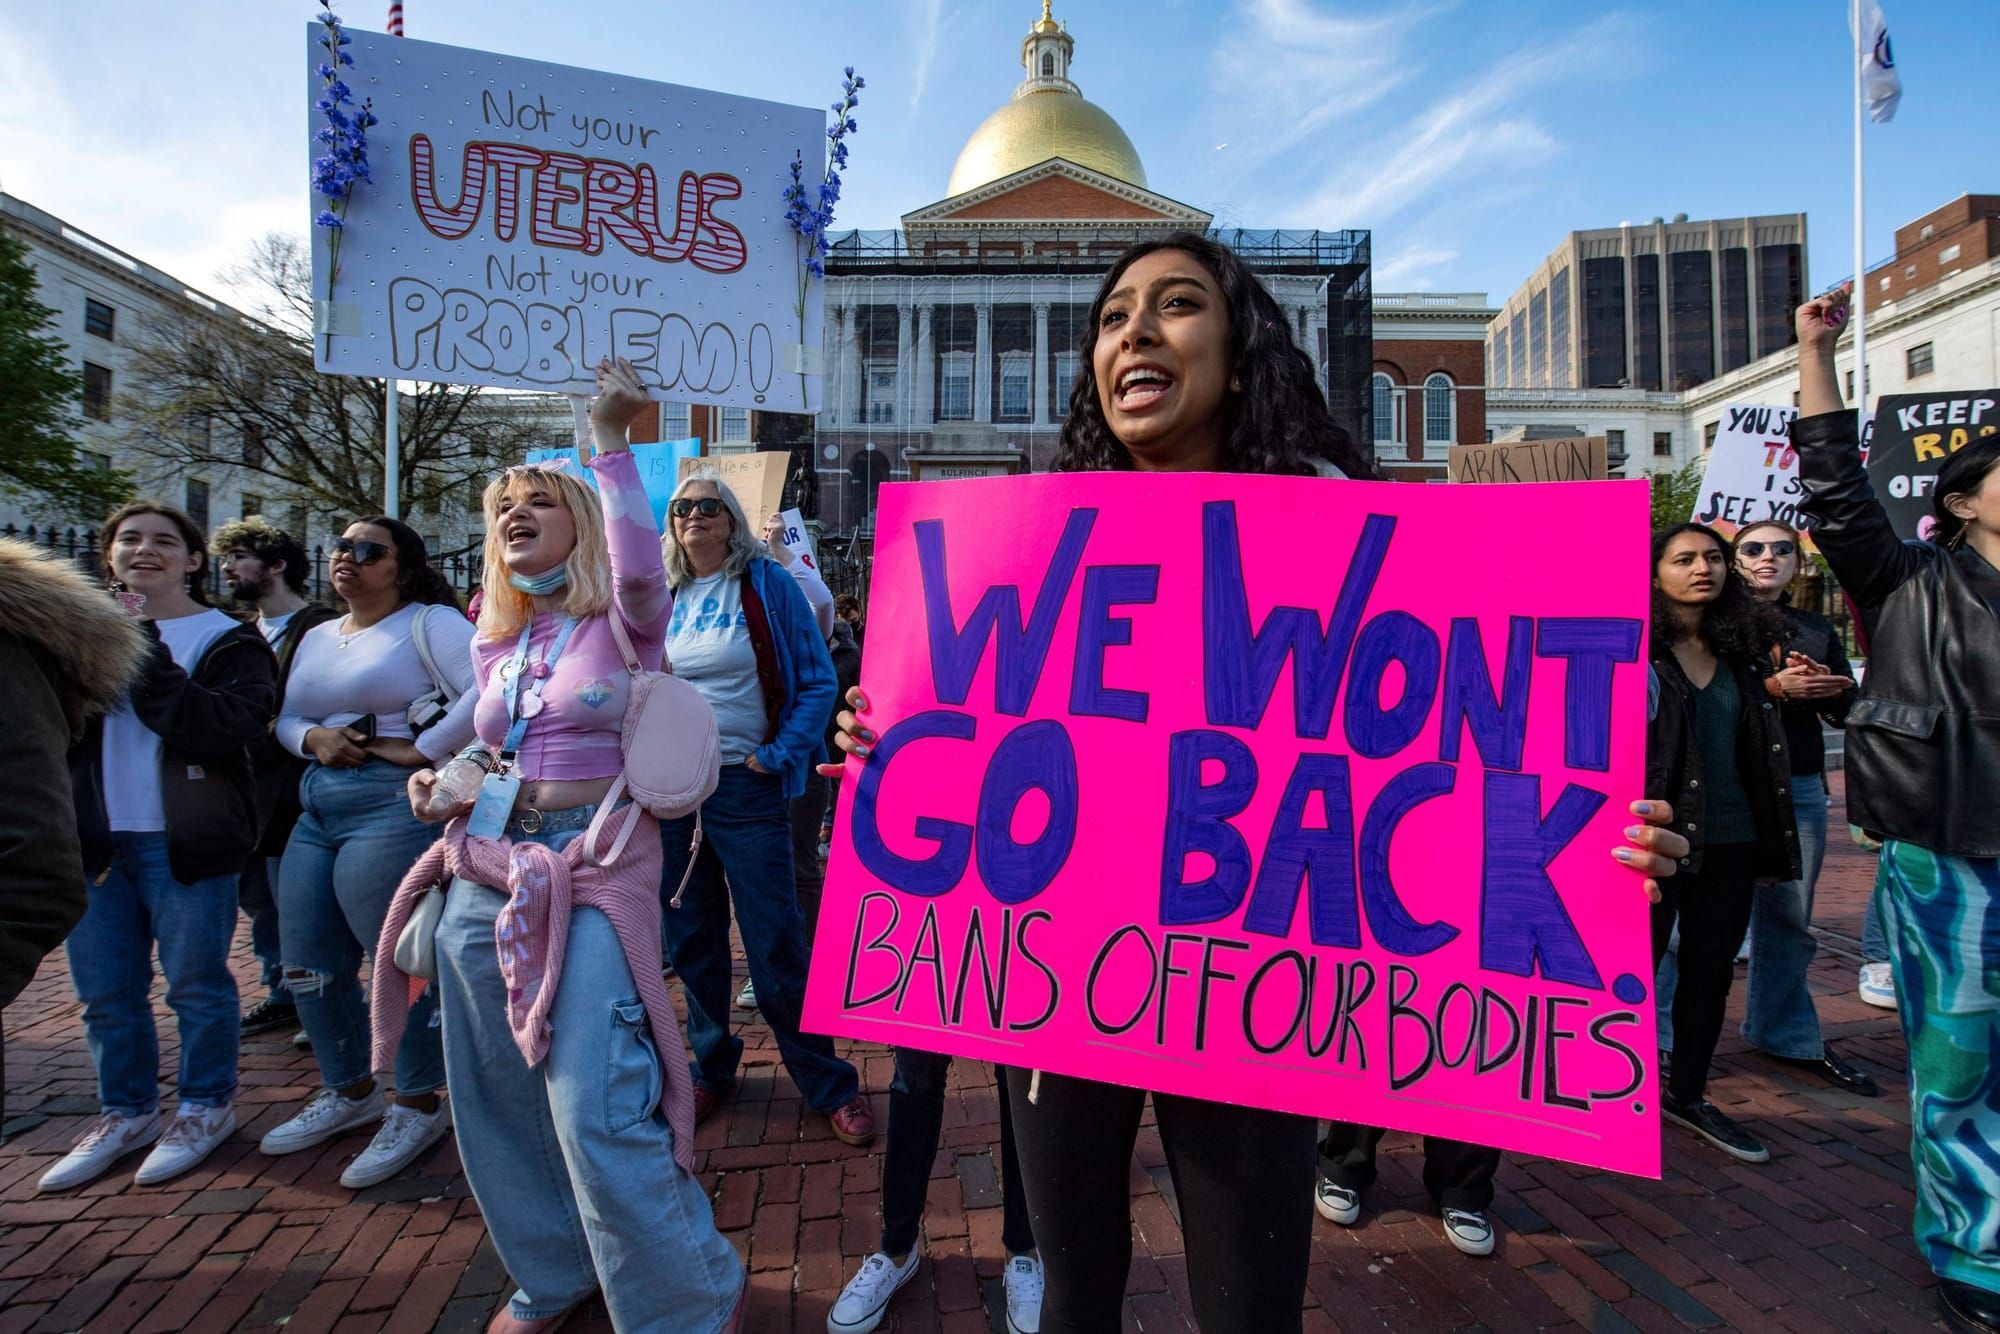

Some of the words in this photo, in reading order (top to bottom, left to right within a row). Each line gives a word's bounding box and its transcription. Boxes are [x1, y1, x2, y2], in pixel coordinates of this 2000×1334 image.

[482, 89, 555, 132] Not
[571, 112, 659, 150] your
[410, 133, 747, 273] UTERUS
[486, 255, 552, 296] Not
[570, 269, 653, 303] your
[389, 276, 774, 403] PROBLEM!
[1727, 407, 1772, 435] YOU
[1897, 398, 1996, 432] KEEP
[940, 468, 988, 478] BULFINCH
[1460, 441, 1593, 483] ABORTION
[1700, 491, 1757, 526] SEE
[913, 508, 1160, 723] WE
[1202, 501, 1644, 772] WONT
[851, 710, 1078, 904] GO
[1160, 730, 1648, 1004] BACK.
[842, 890, 1062, 1032] BANS
[1086, 923, 1251, 1052] OFF
[1241, 949, 1376, 1071] OUR
[1387, 963, 1647, 1115] BODIES.
